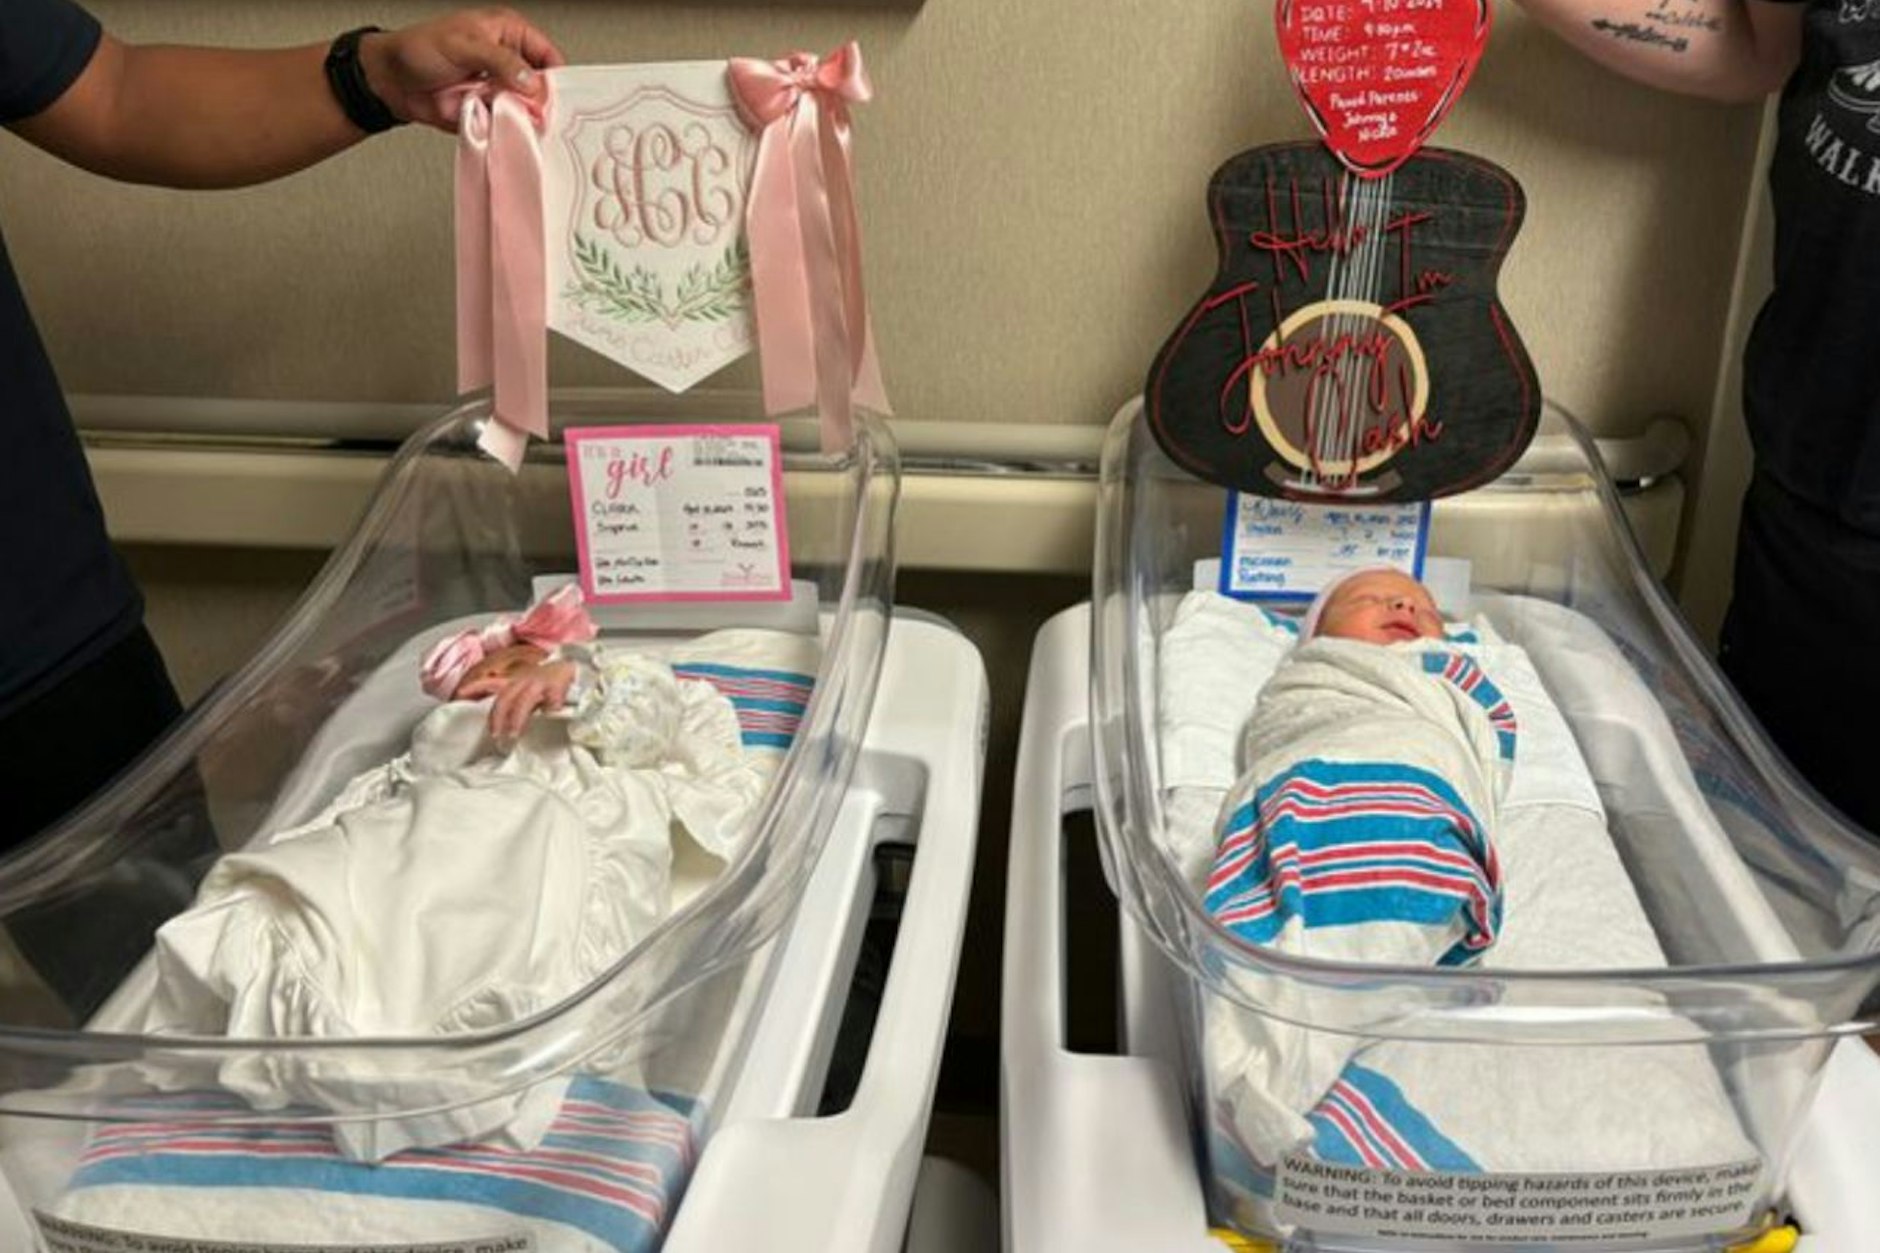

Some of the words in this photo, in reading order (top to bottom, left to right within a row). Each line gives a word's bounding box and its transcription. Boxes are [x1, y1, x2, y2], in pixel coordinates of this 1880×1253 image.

[1203, 282, 1394, 434] Johnny
[1307, 362, 1443, 490] Cash
[606, 445, 674, 500] girl
[1283, 1156, 1377, 1184] WARNING:
[1383, 1171, 1402, 1186] To
[1406, 1175, 1454, 1189] avoid
[1457, 1177, 1519, 1192] tipping
[1523, 1176, 1590, 1191] hazards
[1594, 1175, 1613, 1189] of
[1617, 1174, 1648, 1189] this
[1652, 1170, 1710, 1187] device,
[1283, 1175, 1319, 1194] sure
[1323, 1184, 1358, 1200] that
[1364, 1188, 1394, 1202] the
[1397, 1190, 1454, 1206] basket
[1458, 1196, 1476, 1208] or
[1482, 1195, 1515, 1208] bed
[1519, 1194, 1617, 1210] component
[1622, 1191, 1650, 1206] sits
[1656, 1186, 1704, 1203] firmly
[1707, 1186, 1723, 1199] in
[1727, 1181, 1753, 1197] the
[1283, 1192, 1321, 1211] base
[1325, 1203, 1359, 1218] and
[1363, 1206, 1398, 1220] that
[1403, 1209, 1424, 1222] all
[1486, 1212, 1555, 1226] drawers
[1559, 1211, 1592, 1225] and
[1596, 1210, 1655, 1225] casters
[1658, 1207, 1687, 1220] are
